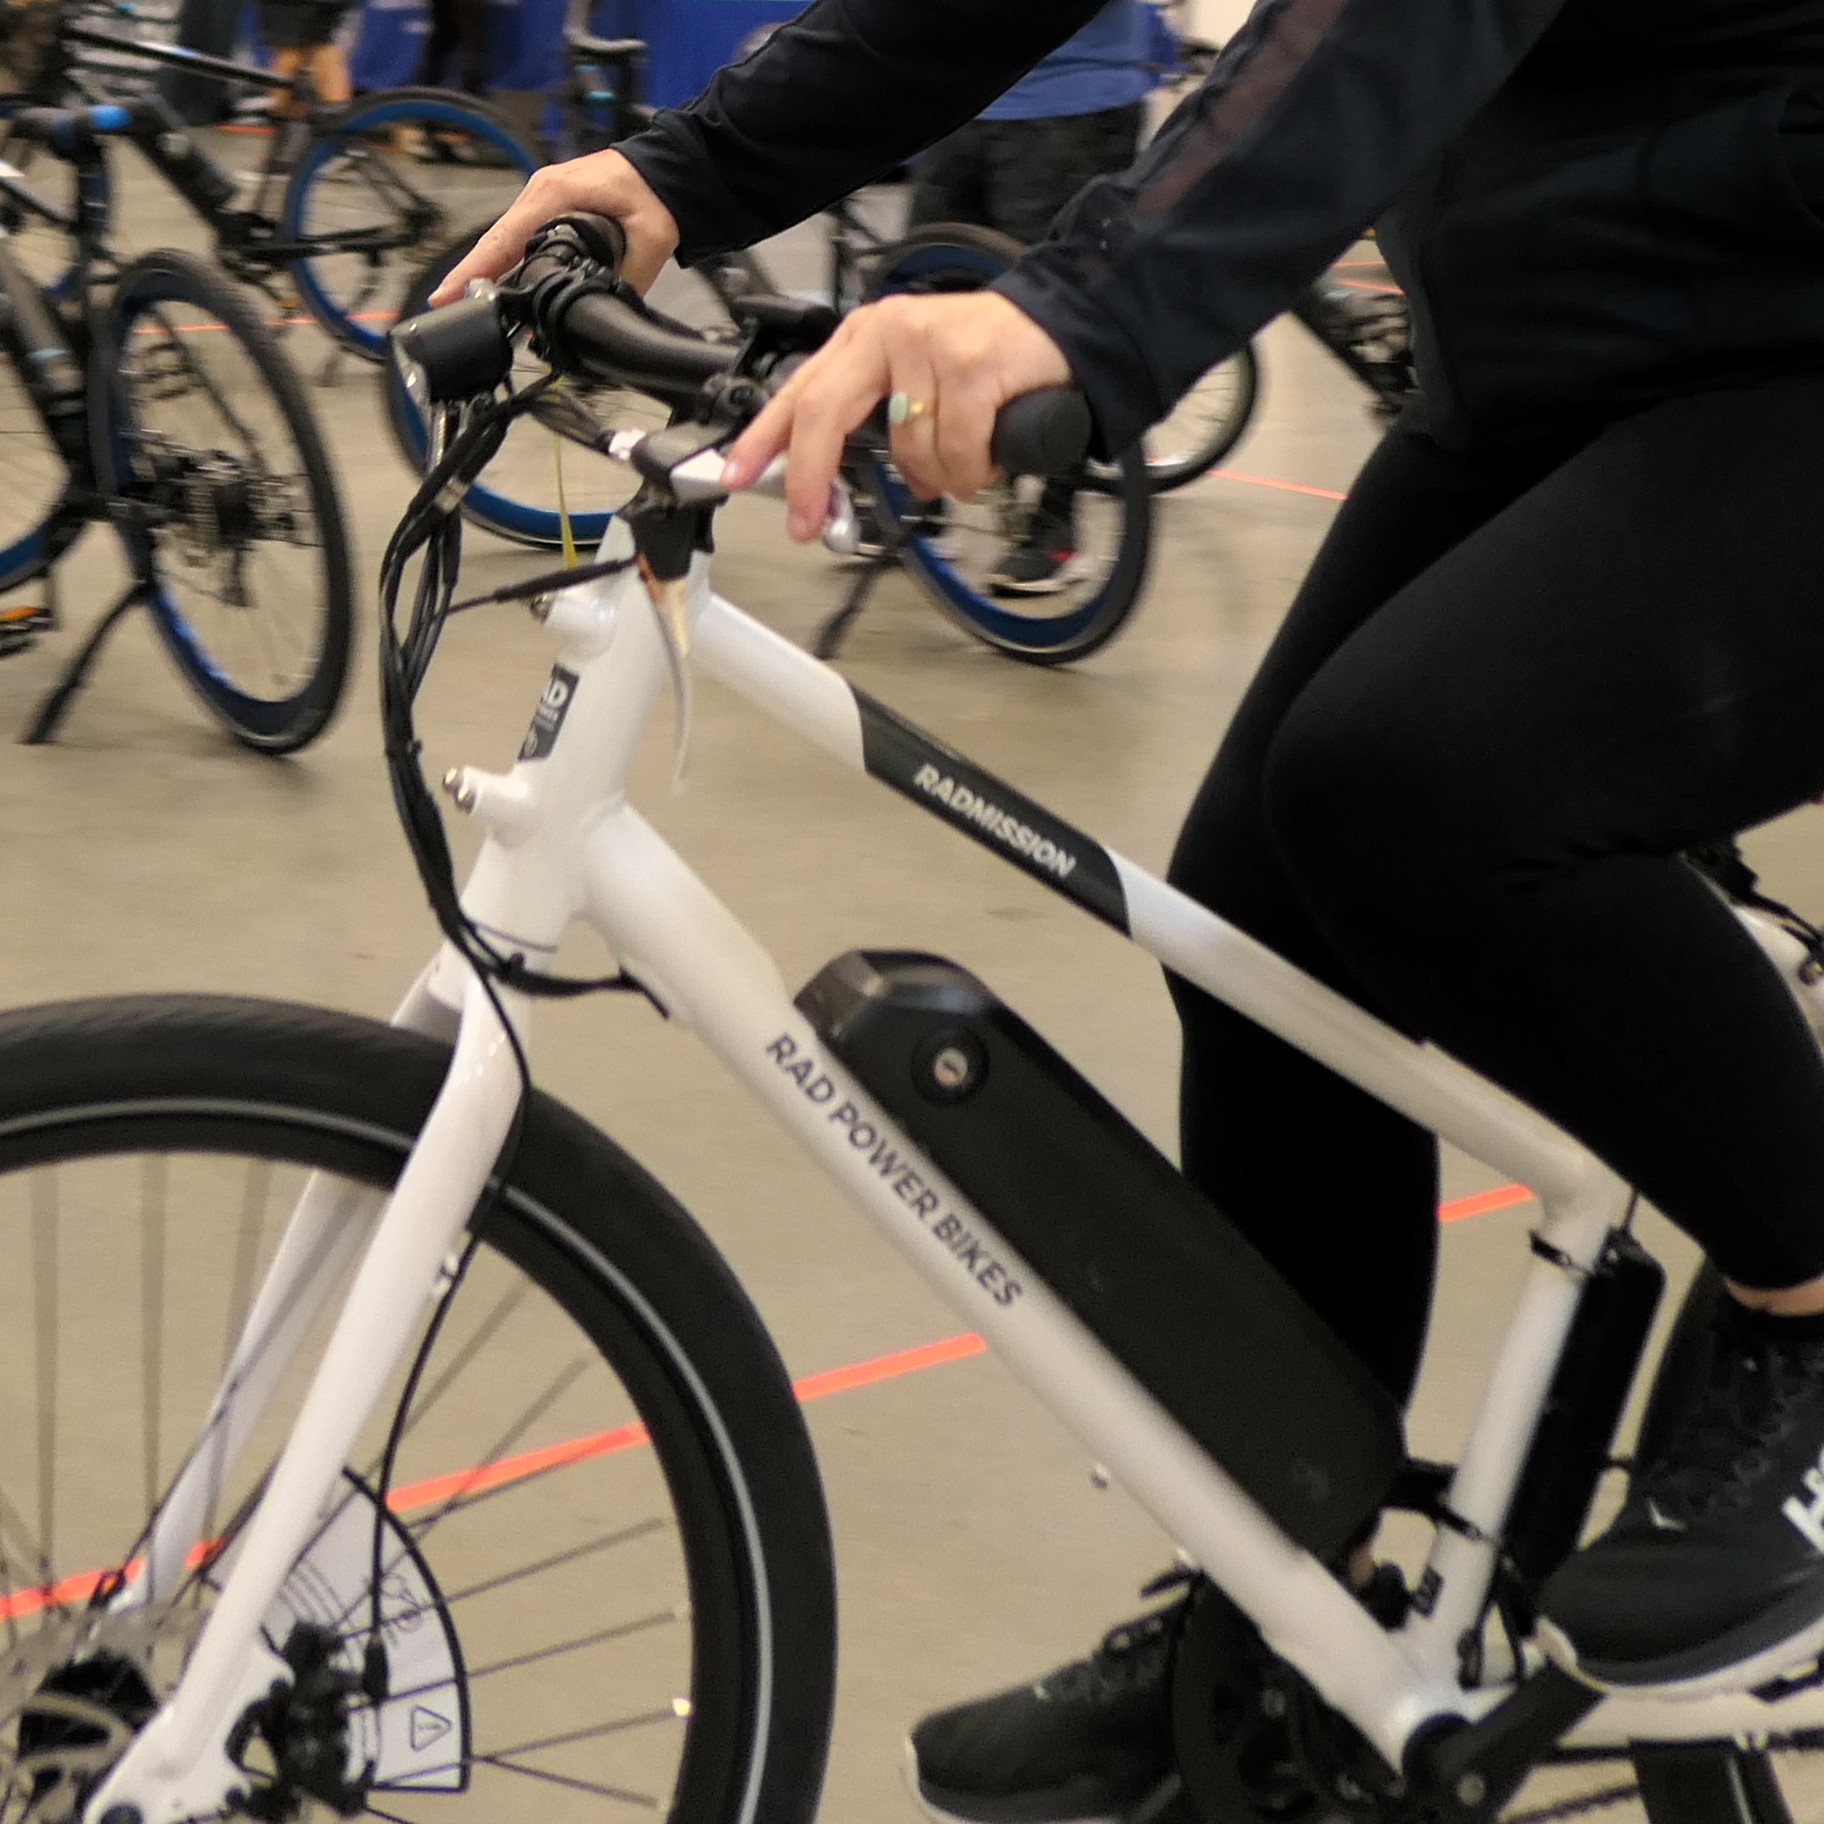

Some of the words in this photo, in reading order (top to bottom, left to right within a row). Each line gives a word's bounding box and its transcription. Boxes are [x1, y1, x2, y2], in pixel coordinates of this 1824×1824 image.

[913, 762, 1077, 878] RADMISSION
[766, 1032, 836, 1103] RAD
[828, 1100, 940, 1221] POWER
[932, 1212, 1024, 1307] BIKES
